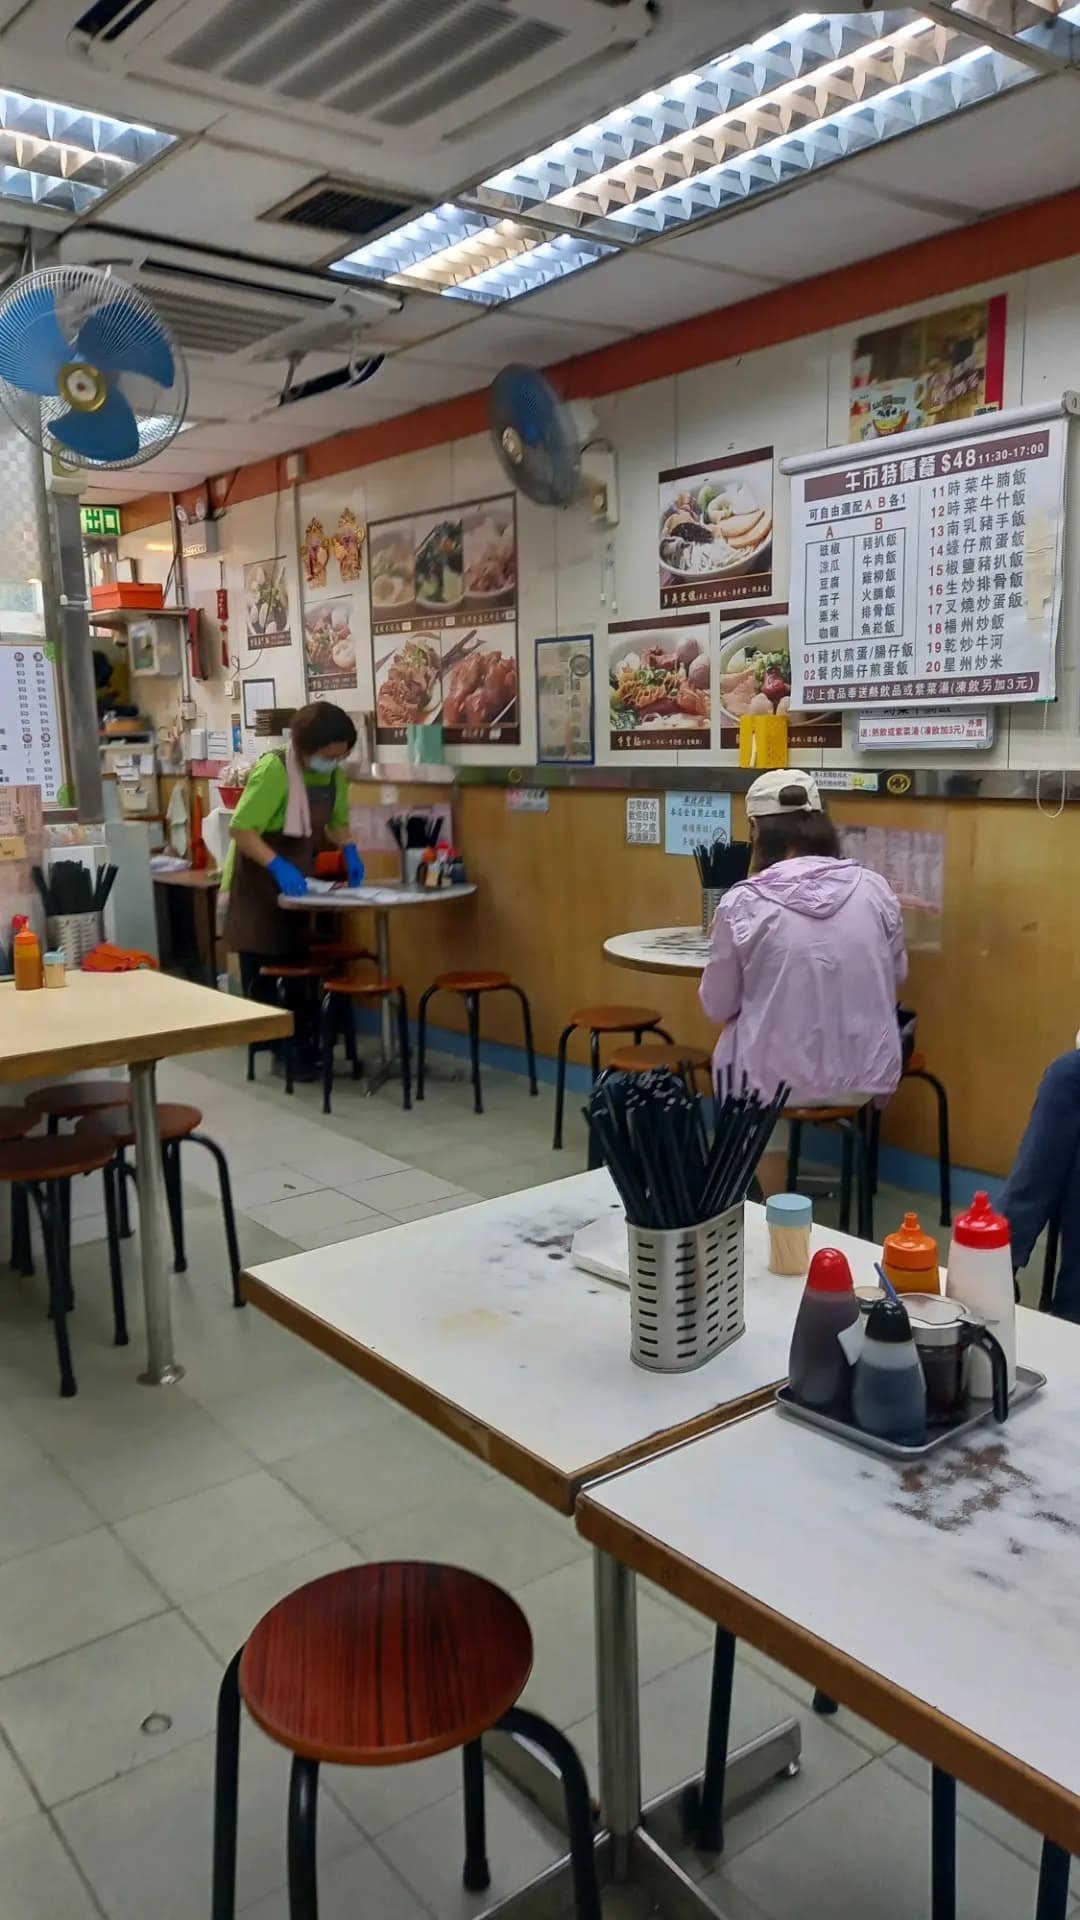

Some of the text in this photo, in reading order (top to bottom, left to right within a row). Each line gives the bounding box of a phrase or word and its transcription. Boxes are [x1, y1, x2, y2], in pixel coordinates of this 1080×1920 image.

[845, 443, 1044, 491] 午市特價餐 $48 11:30-17:00
[809, 500, 862, 520] 可自由選配
[931, 505, 944, 518] 12
[84, 508, 120, 534] 出口
[874, 517, 883, 530] B
[825, 525, 834, 539] A
[930, 525, 944, 538] 13
[929, 544, 943, 557] 14
[863, 550, 897, 567] 牛肉飯
[929, 564, 943, 577] 15
[819, 576, 840, 590] 豆腐
[928, 584, 943, 596] 16
[818, 592, 840, 607] 茄子
[862, 602, 896, 619] 排骨飯
[928, 603, 942, 615] 17
[928, 622, 942, 634] 18
[927, 634, 1004, 654] 19 乾炒牛河
[926, 653, 1004, 673] 20 星州炒米
